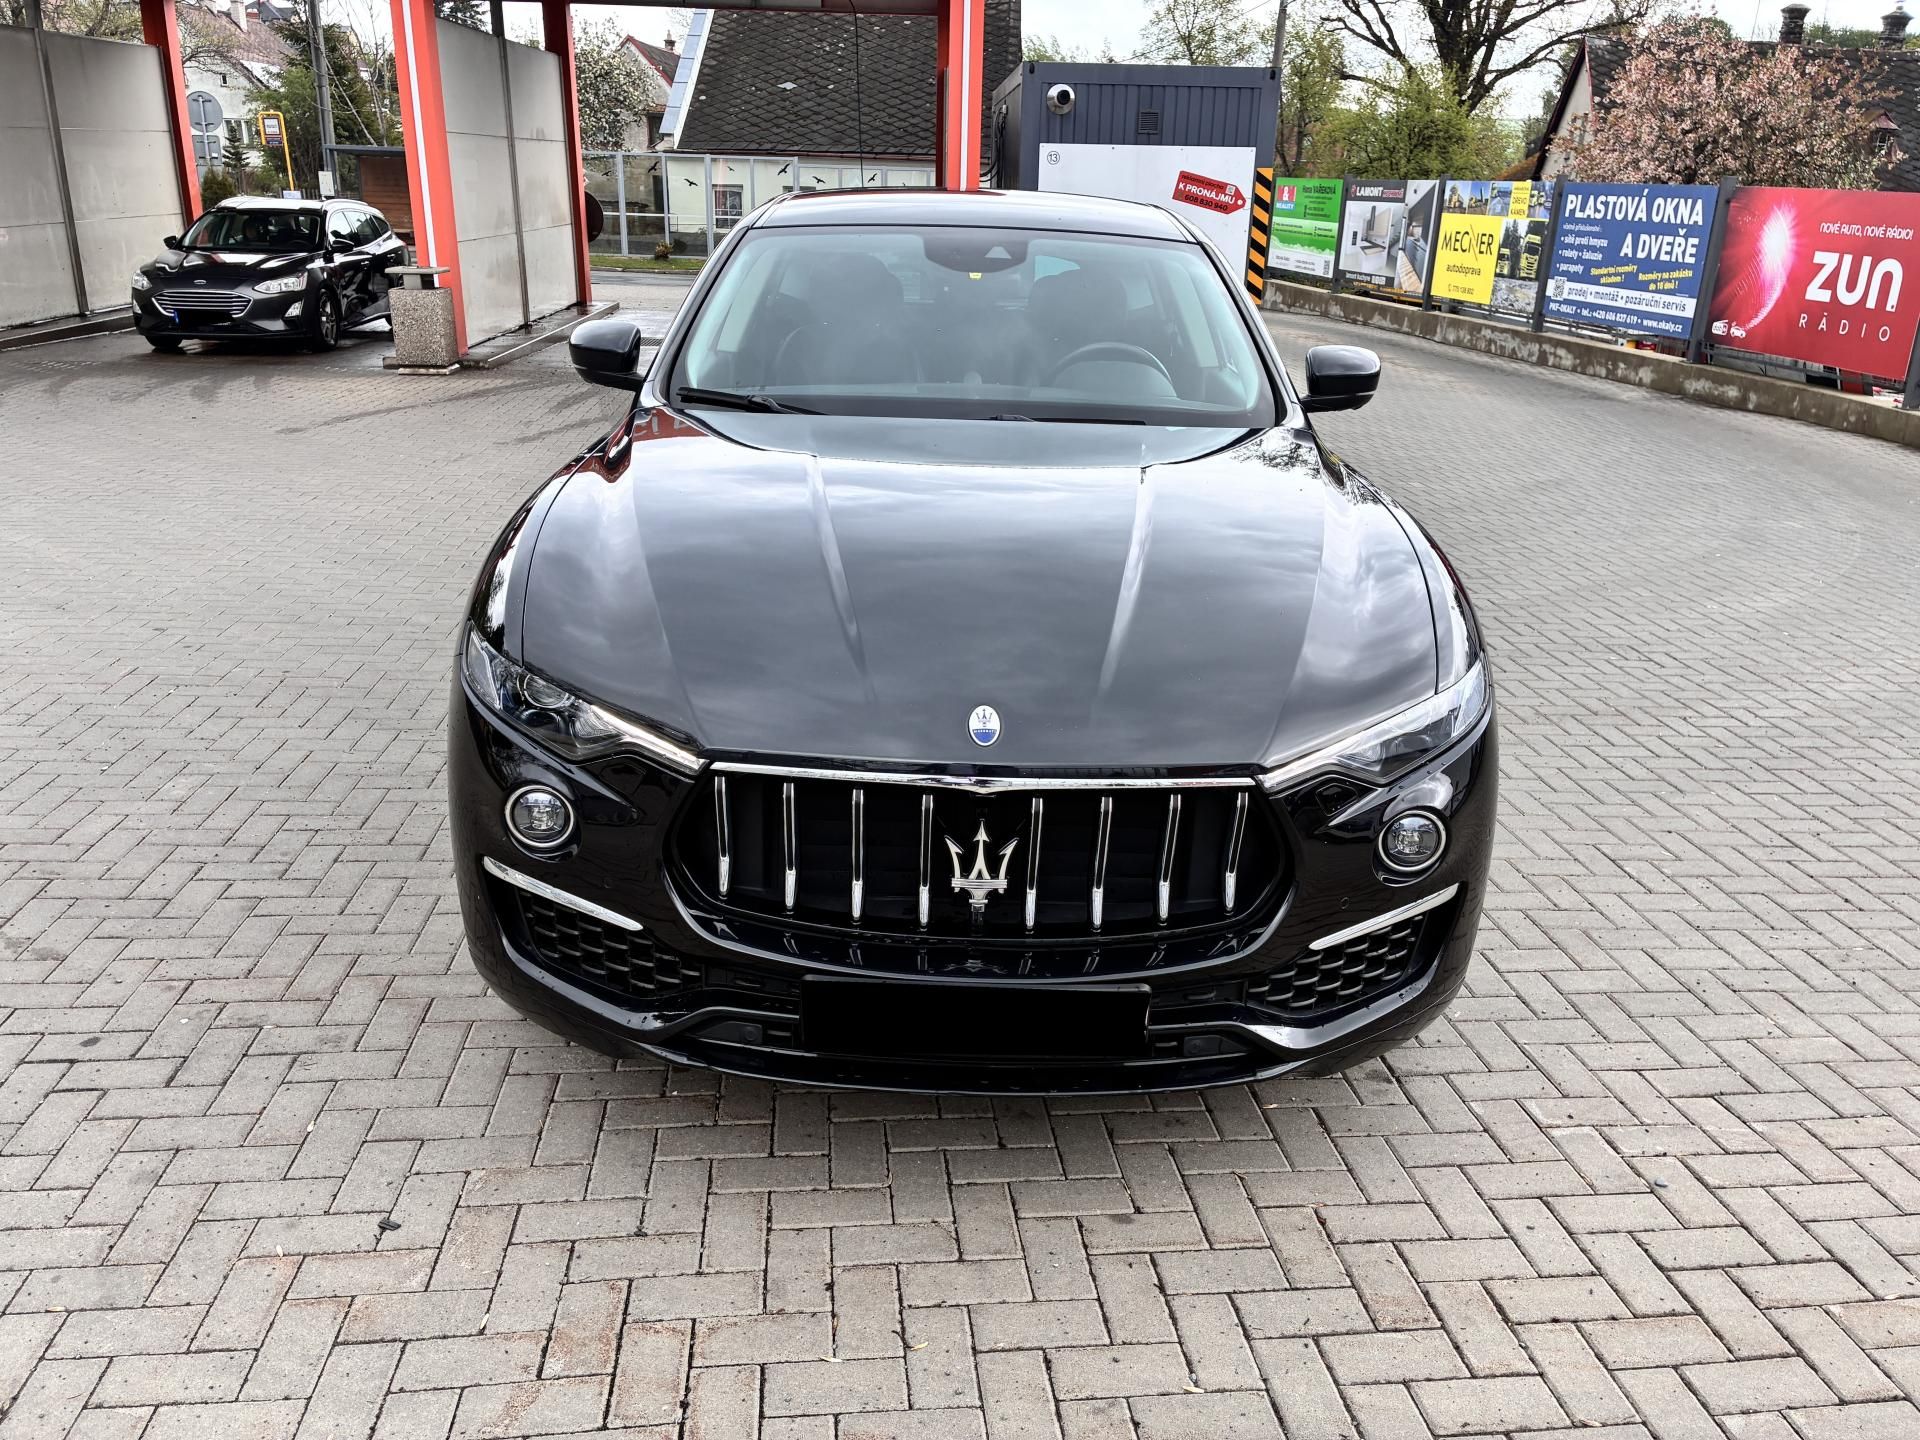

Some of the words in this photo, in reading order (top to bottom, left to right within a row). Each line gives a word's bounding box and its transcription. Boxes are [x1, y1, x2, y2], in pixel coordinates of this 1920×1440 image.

[1178, 182, 1186, 191] K
[1186, 184, 1236, 204] PRONÁJMU
[1205, 181, 1224, 190] plocha
[1356, 186, 1384, 197] LAMONT
[1184, 194, 1199, 203] 608
[1213, 202, 1228, 211] 940
[1564, 188, 1649, 223] PLASTOVÁ
[1652, 197, 1703, 226] OKNA
[1820, 221, 1841, 234] NOVÉ
[1841, 223, 1862, 237] AUTO,
[1864, 224, 1886, 238] NOVÉ
[1886, 225, 1914, 240] RÁDIO!
[1441, 228, 1494, 257] MECNER
[1620, 232, 1633, 258] A
[1636, 228, 1699, 264] DVEŘE
[1446, 264, 1481, 277] autodoprava
[1559, 263, 1584, 274] parapety
[1805, 251, 1903, 312] ZUN
[1567, 286, 1589, 299] prodej
[1594, 288, 1619, 302] montáž
[1625, 293, 1661, 308] pozáruční
[1661, 300, 1687, 312] servis
[1643, 318, 1683, 332] www.okaly.cz
[1799, 313, 1891, 341] RÁDIO
